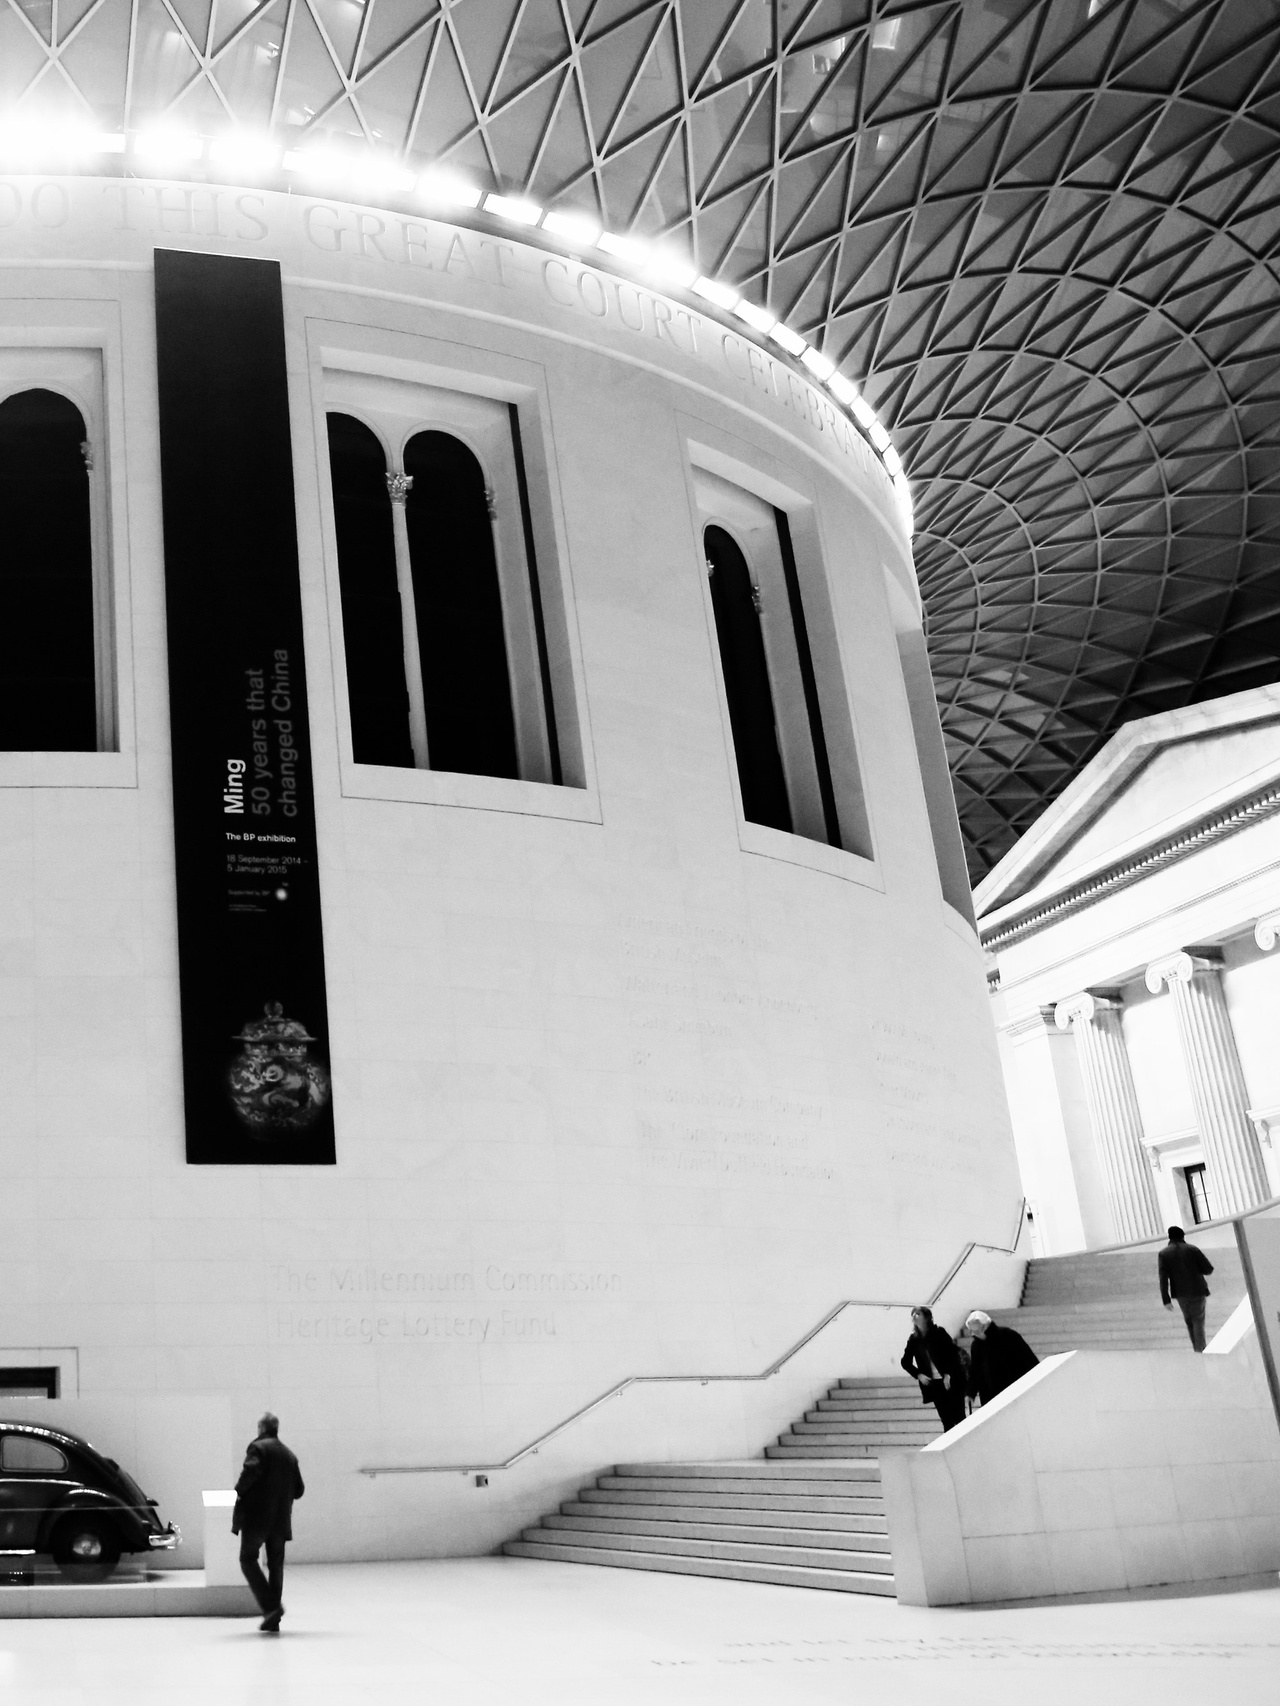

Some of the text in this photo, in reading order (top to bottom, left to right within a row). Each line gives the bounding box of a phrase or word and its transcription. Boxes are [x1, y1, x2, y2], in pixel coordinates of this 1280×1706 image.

[105, 182, 274, 243] THIS
[301, 204, 518, 289] GREAT
[539, 255, 705, 355] COURT
[245, 668, 273, 815] 50 years that
[271, 648, 298, 817] changed China
[224, 759, 246, 814] Ming
[225, 832, 296, 843] The BP exhibition
[226, 854, 236, 863] 18
[238, 854, 279, 865] September
[281, 856, 302, 865] 2014
[227, 864, 288, 876] 5 January 2015
[269, 1264, 623, 1294] The Millennium Commission
[276, 1309, 558, 1344] Heritage Lottery Fund
